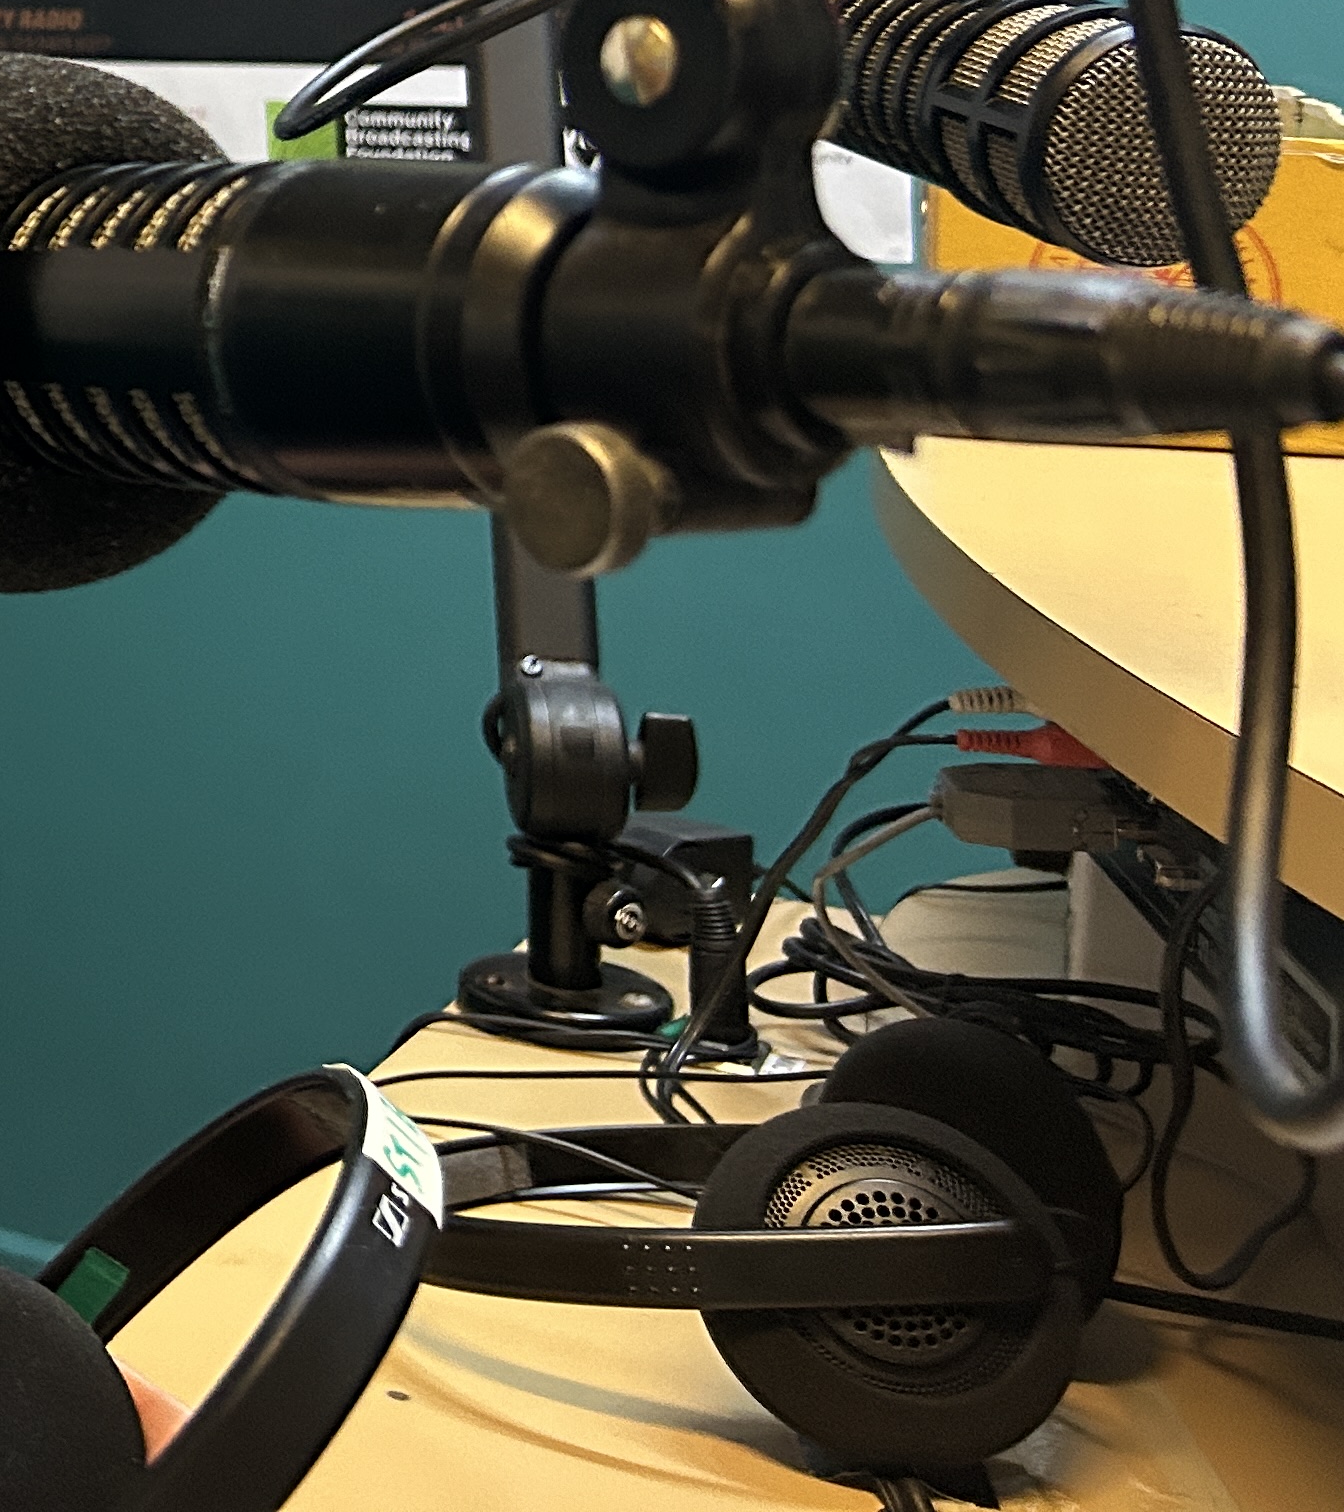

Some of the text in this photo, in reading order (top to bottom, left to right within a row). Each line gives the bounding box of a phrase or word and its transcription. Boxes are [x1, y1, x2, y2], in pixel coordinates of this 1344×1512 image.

[16, 7, 85, 30] RADIO
[344, 108, 455, 132] Community
[345, 128, 471, 153] Broadcasting
